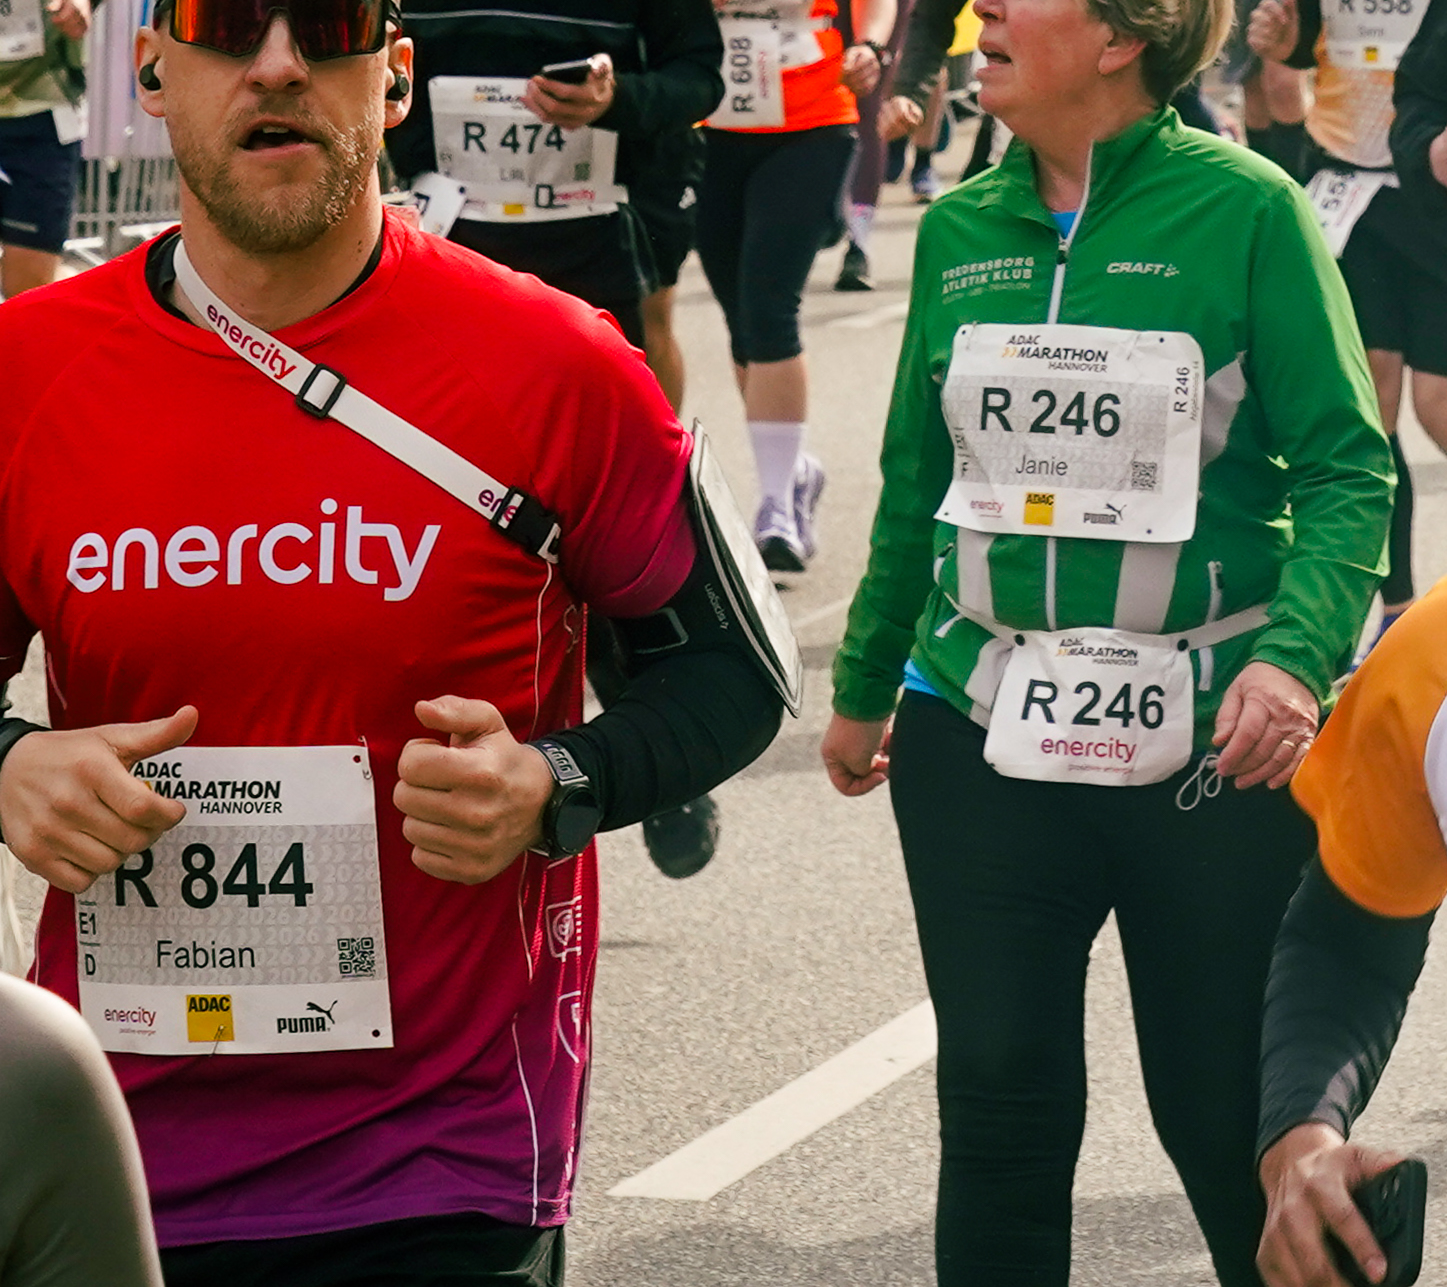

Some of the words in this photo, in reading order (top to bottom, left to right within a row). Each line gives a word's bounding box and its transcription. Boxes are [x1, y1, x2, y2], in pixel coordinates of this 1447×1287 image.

[464, 121, 487, 153] R
[500, 123, 566, 154] 474
[942, 256, 1034, 281] FREDENSBORG
[1107, 262, 1165, 275] CRAFT
[942, 275, 989, 295] ATLETIK
[992, 268, 1033, 281] KLUB
[206, 304, 297, 380] enercity
[1007, 334, 1041, 346] ADAC
[1017, 346, 1109, 363] MARATHON
[1048, 361, 1108, 373] HANNOVER
[1176, 366, 1191, 397] 246
[979, 387, 1013, 432] R
[1028, 389, 1122, 438] 246
[1173, 399, 1188, 414] R
[1016, 454, 1069, 476] Janie
[66, 498, 442, 602] enercity
[1068, 646, 1139, 659] MARATHON
[1020, 679, 1059, 725] R
[1071, 681, 1166, 730] 246
[1040, 737, 1138, 764] enercity
[133, 762, 182, 779] ADAC
[151, 780, 281, 800] MARATHON
[199, 801, 283, 815] HANNOVER
[114, 847, 159, 908] R
[181, 842, 314, 909] 844
[79, 912, 97, 935] E1
[85, 954, 96, 975] D
[156, 940, 256, 969] Fabian
[188, 996, 231, 1013] ADAC
[104, 1007, 156, 1027] enercity
[277, 1017, 326, 1034] PUMA
